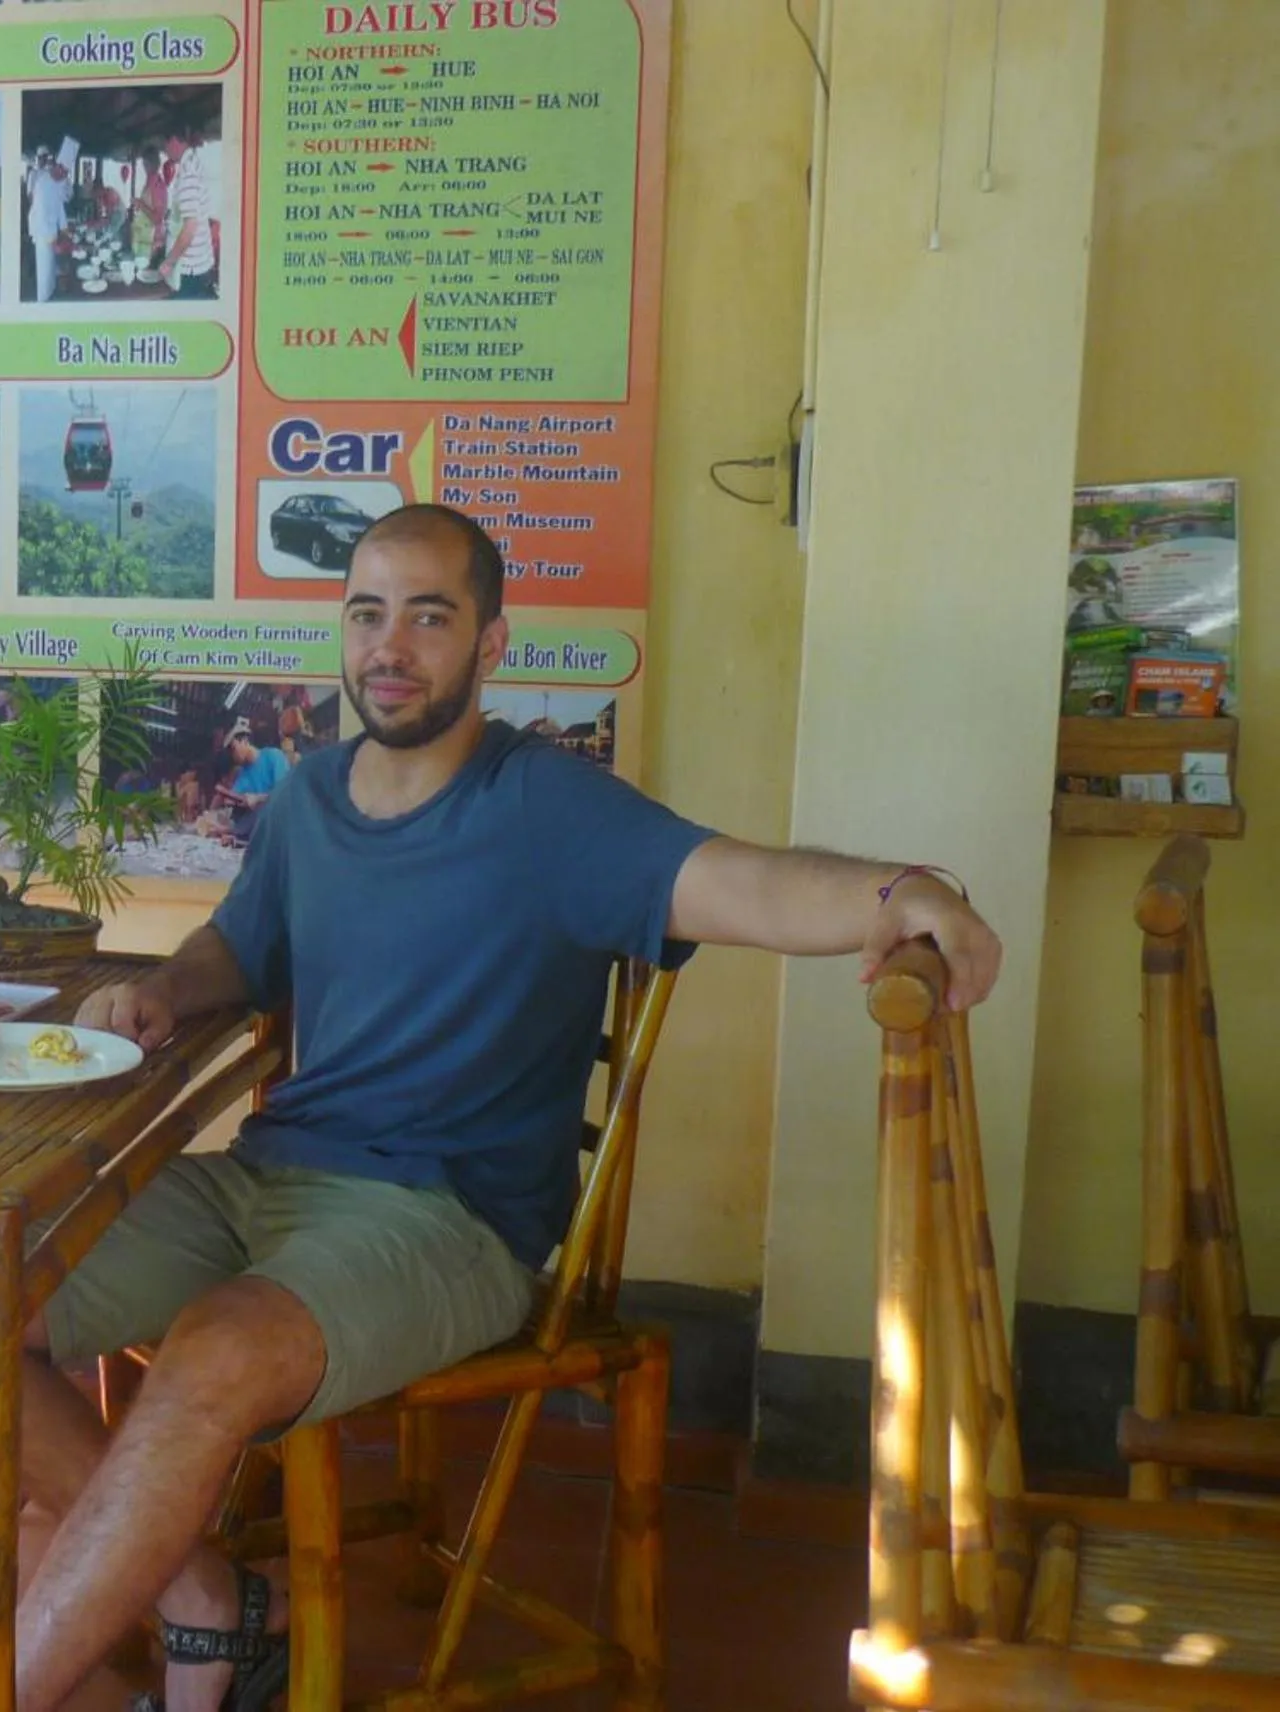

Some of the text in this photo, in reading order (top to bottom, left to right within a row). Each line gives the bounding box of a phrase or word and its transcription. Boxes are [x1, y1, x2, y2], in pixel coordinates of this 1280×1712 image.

[324, 0, 558, 35] DAILY BUS
[41, 31, 203, 70] Cooking Class
[288, 61, 476, 82] HOI AN HUE
[287, 92, 600, 116] HOI AN HUE NINH BINH HA NOI
[286, 157, 527, 176] HOI AN NHA TRANG
[527, 191, 603, 205] DA LAT
[285, 202, 501, 220] HOI AN NHA TRANG
[526, 210, 602, 224] MUI NE
[284, 248, 603, 267] HOI AN NHA TRANG DA LAT MUI NE SAI GON
[422, 291, 557, 308] SAVANAKHET
[422, 317, 517, 332] VIENTIAN
[283, 328, 390, 347] HOI AN
[58, 336, 177, 365] Ba Na Hills
[422, 341, 524, 357] SIEM RIEP
[421, 367, 554, 383] PHNOM PENH
[444, 416, 614, 434] Da Nang Airport
[272, 420, 399, 473] Car
[443, 441, 579, 456] Train Station
[443, 465, 618, 481] Marble Mountain
[442, 488, 517, 504] My Son
[506, 513, 591, 528] Museum
[503, 561, 581, 576] ity Tour
[112, 623, 331, 642] Carving Wooden Furniture
[15, 632, 78, 663] Village
[524, 643, 556, 669] Bon
[563, 642, 607, 670] River
[139, 650, 302, 671] Of Cam Kim Village
